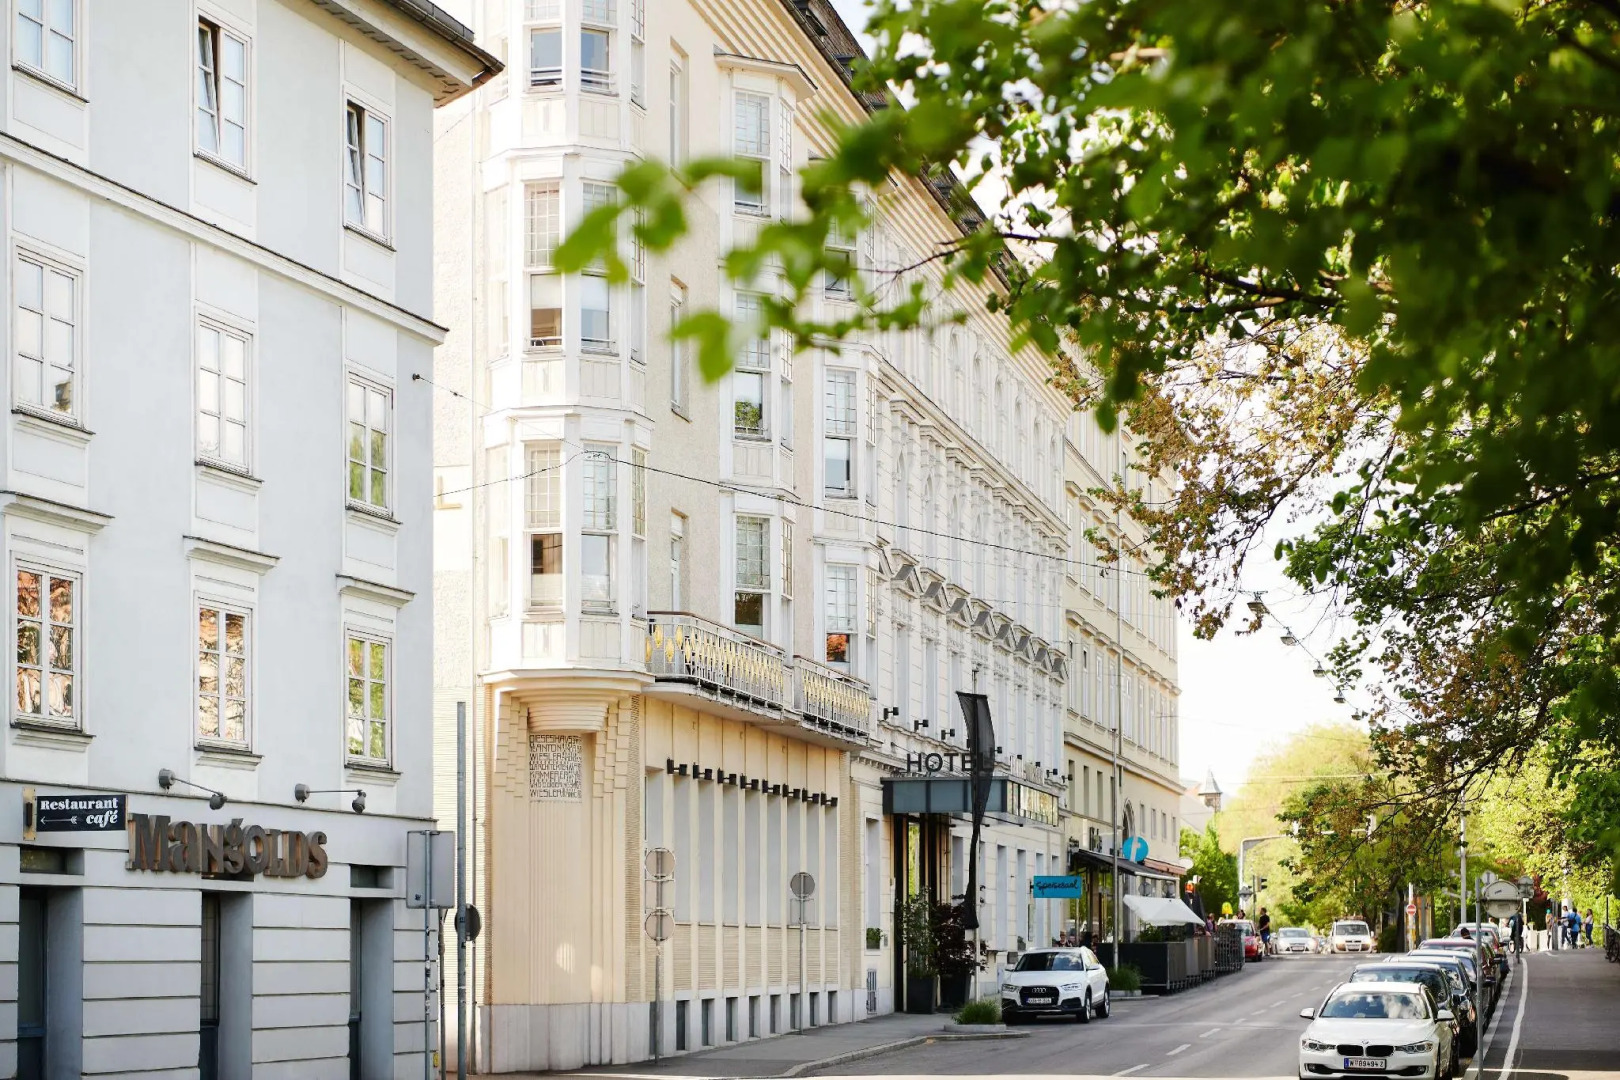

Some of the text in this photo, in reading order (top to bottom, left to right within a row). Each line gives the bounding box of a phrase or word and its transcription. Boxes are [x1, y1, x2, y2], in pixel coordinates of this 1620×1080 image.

[906, 752, 994, 773] HOTEL
[40, 797, 118, 811] Restaurant
[85, 809, 118, 828] café
